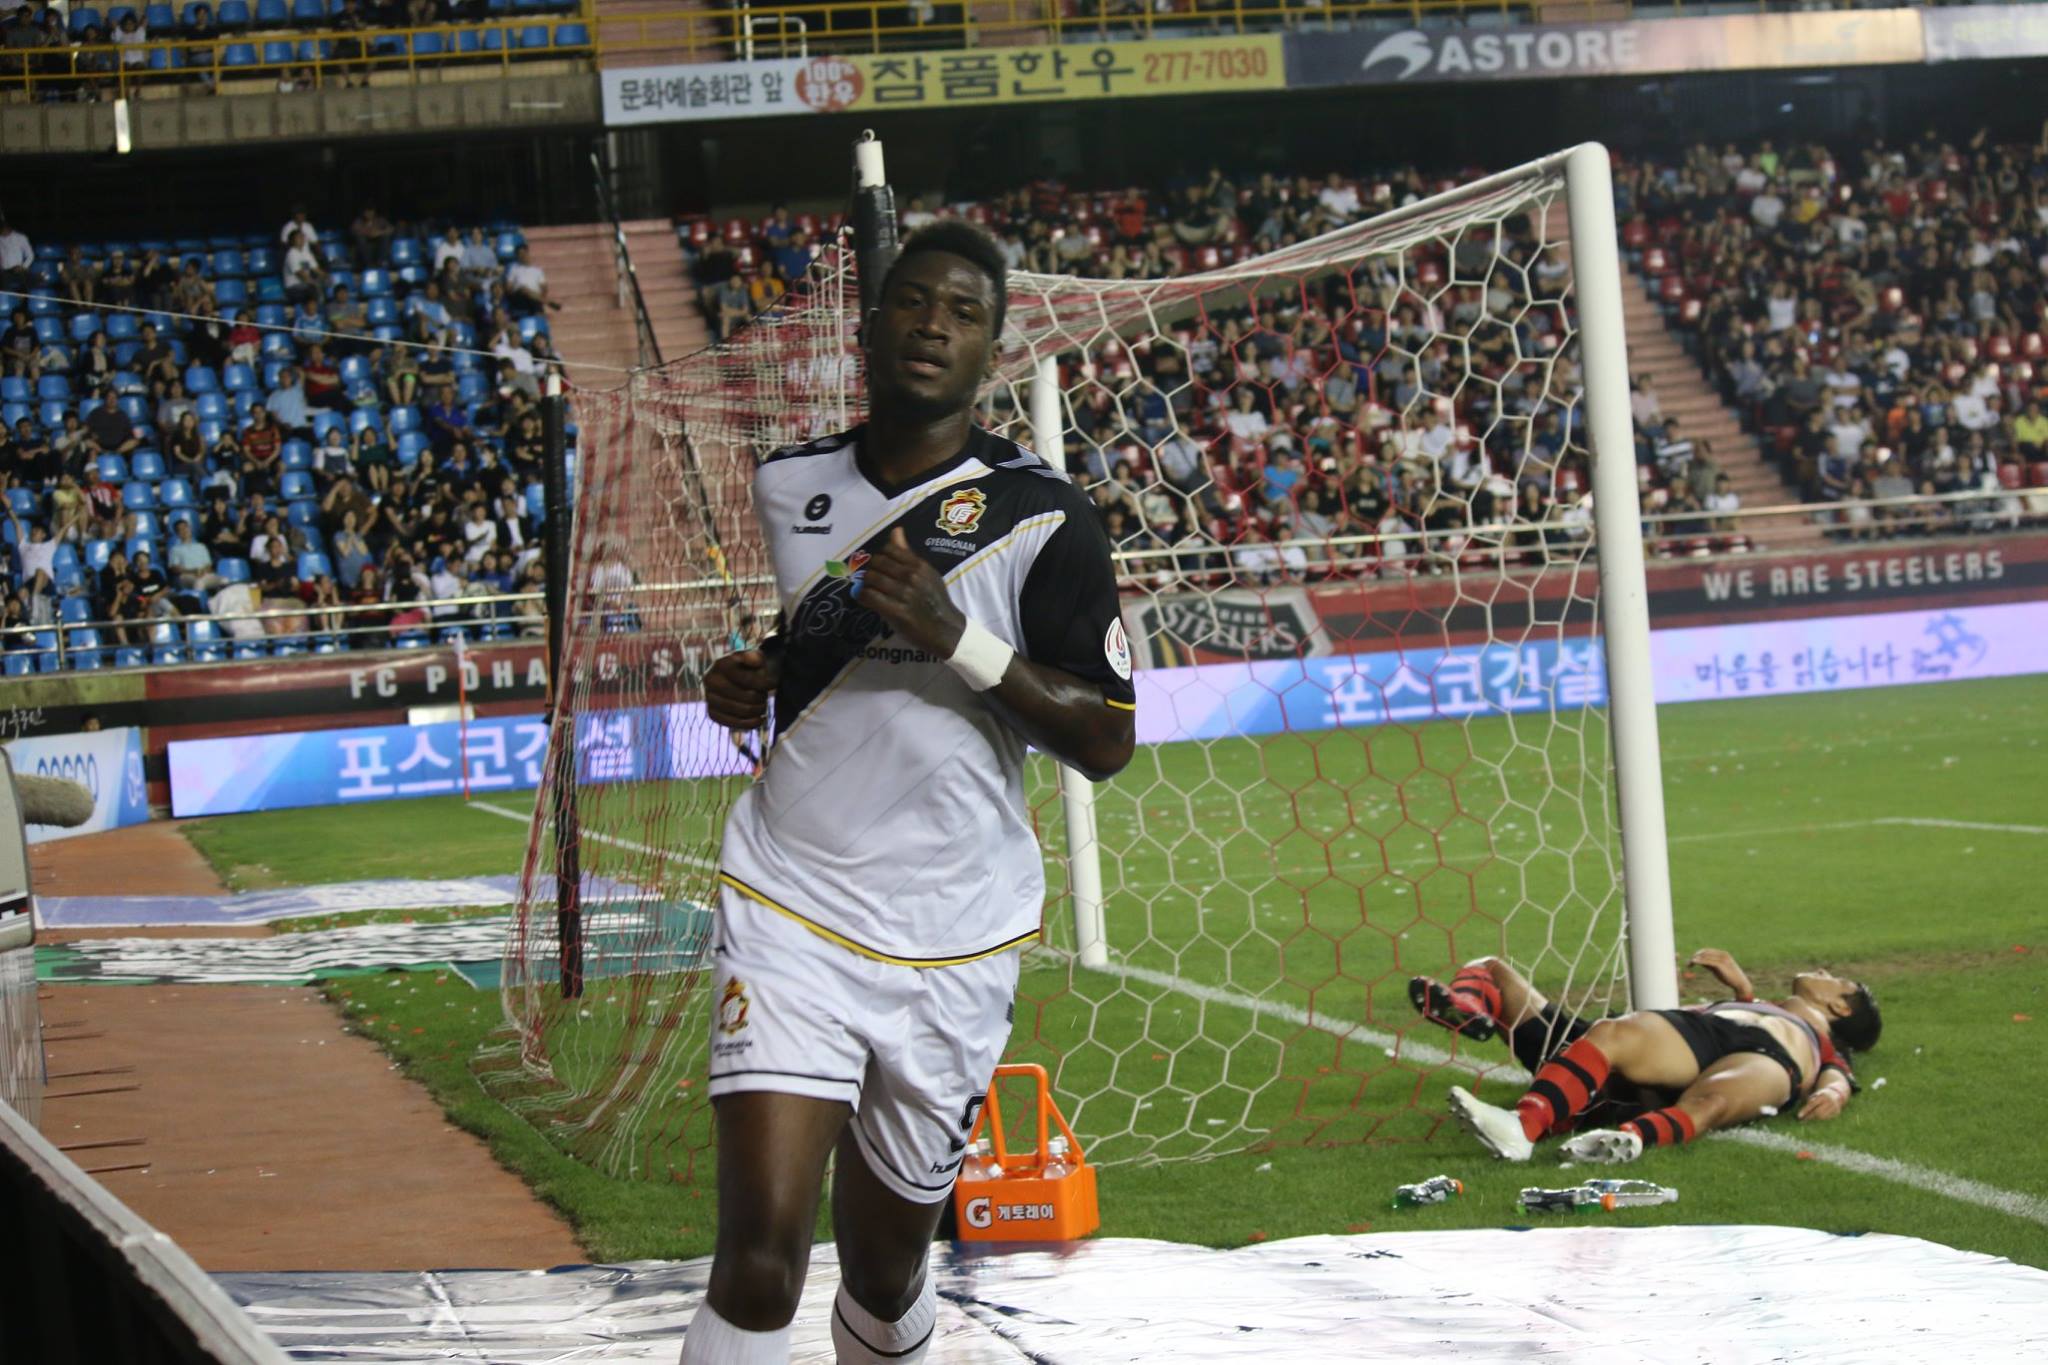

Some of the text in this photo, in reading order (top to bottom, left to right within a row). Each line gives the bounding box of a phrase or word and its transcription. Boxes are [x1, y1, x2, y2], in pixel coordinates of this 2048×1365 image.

[1143, 47, 1269, 84] 277-7030
[1437, 29, 1642, 74] ASTORE
[620, 71, 783, 111] 문화예술회관 앞
[870, 49, 1135, 102] 참품한우
[1704, 550, 2005, 601] WE ARE STEELERS
[855, 645, 944, 665] eongna
[1695, 651, 1780, 692] 마음을
[1792, 642, 1900, 686] 읽습니다
[350, 669, 398, 699] FC
[1322, 644, 1604, 724] 포스코건설
[998, 1204, 1055, 1221] 게토레이
